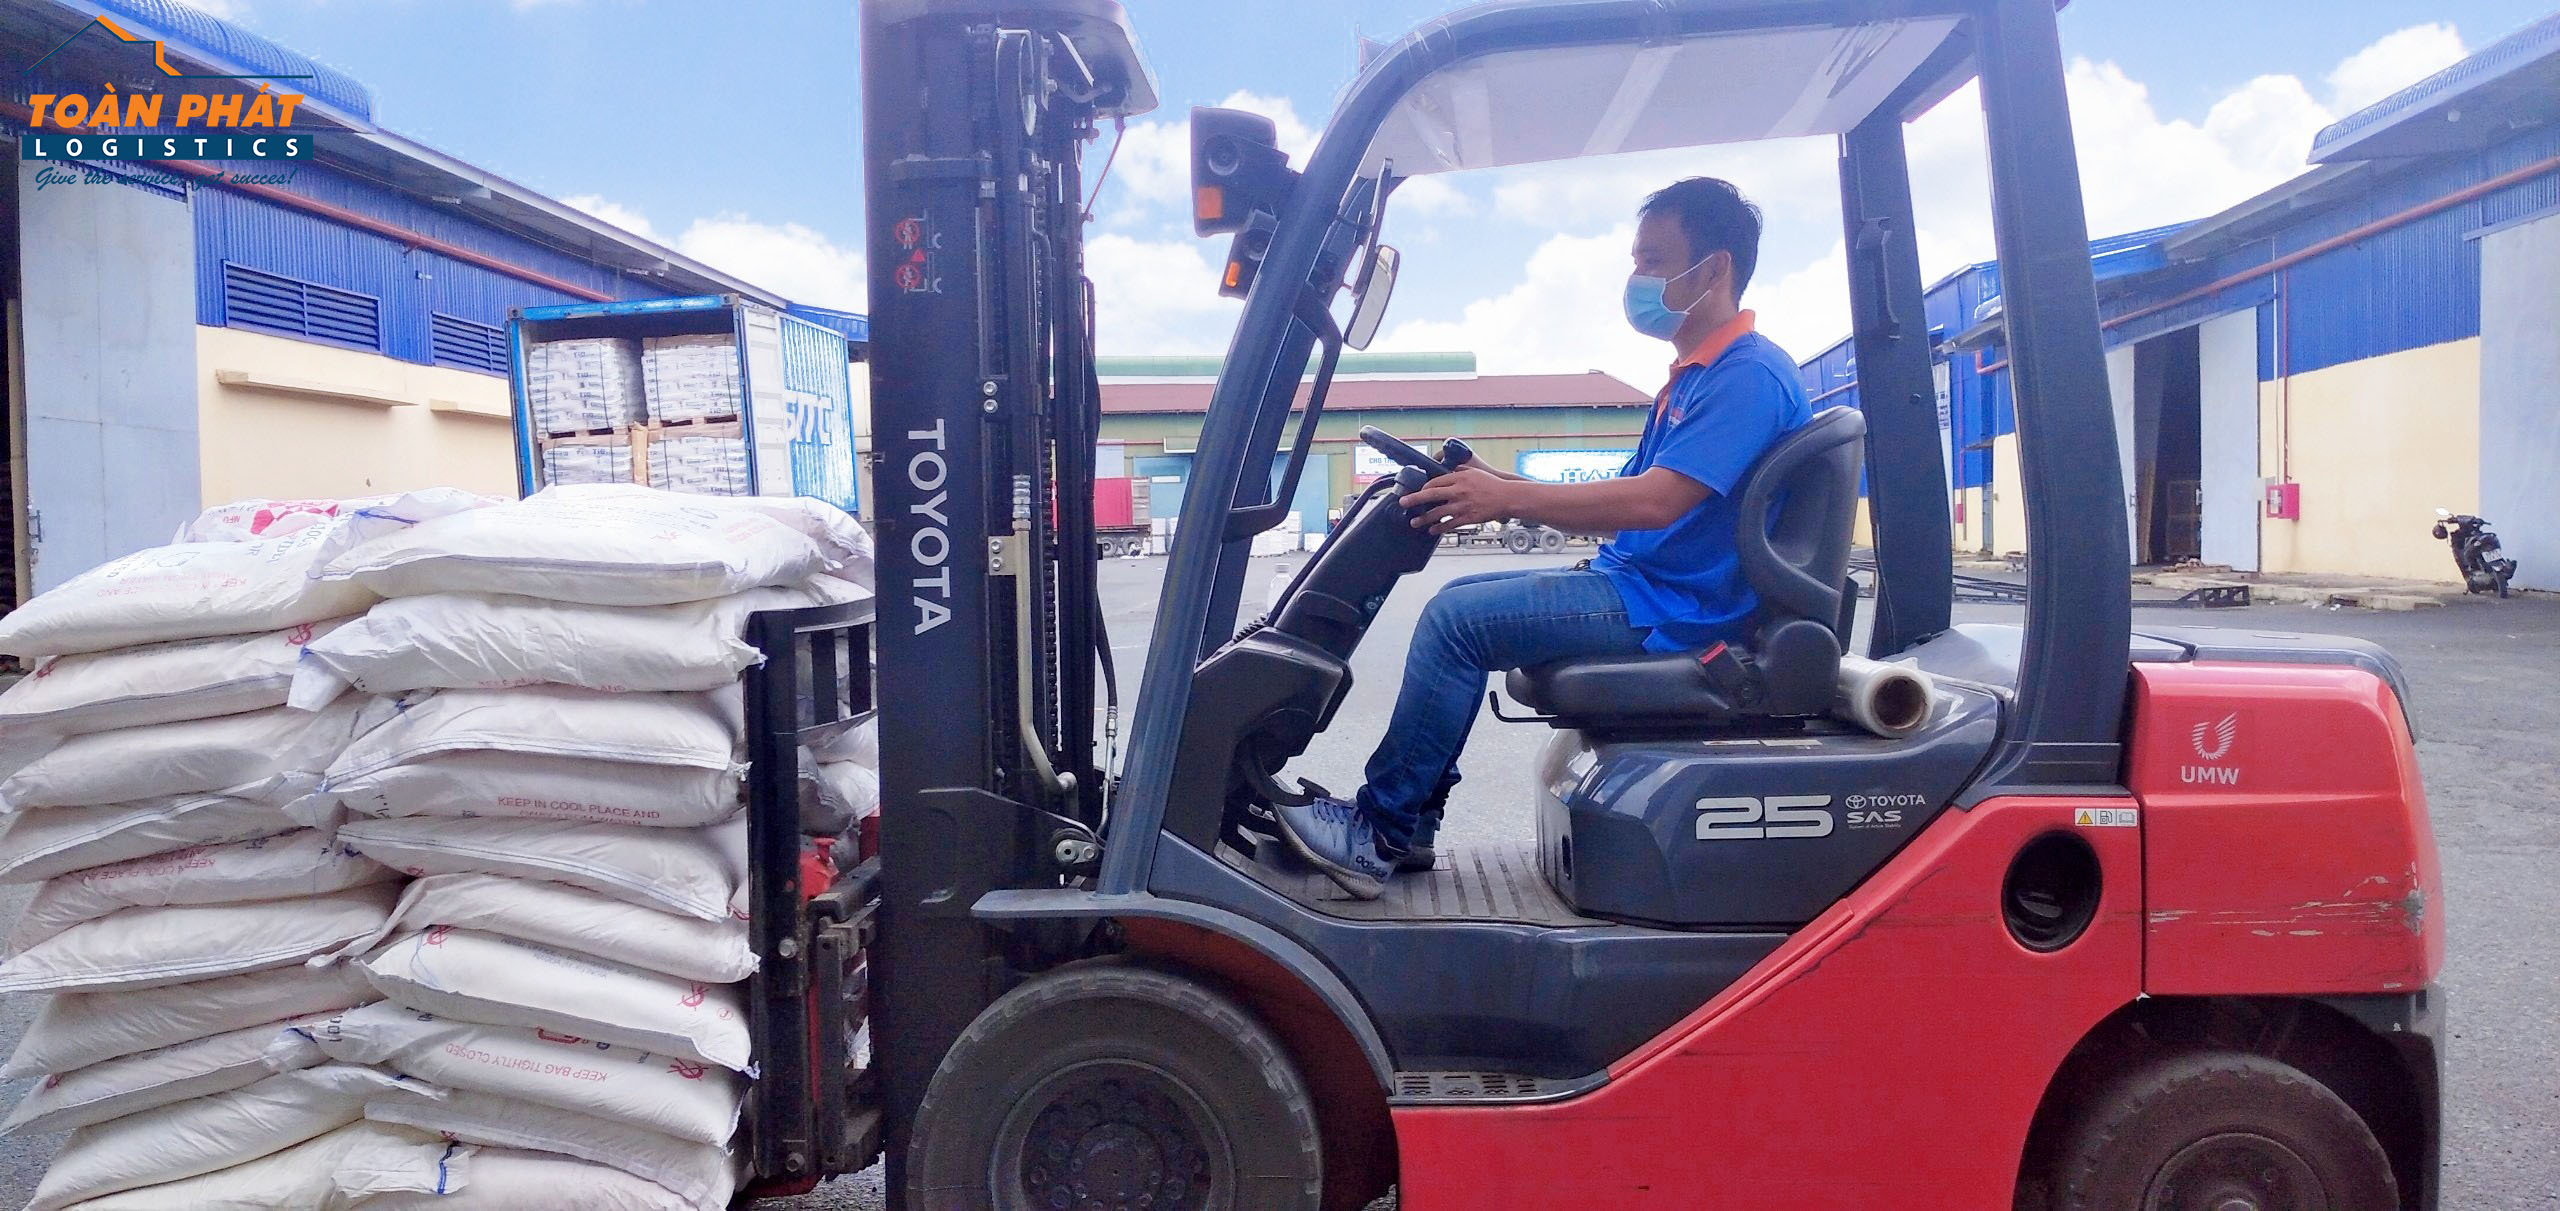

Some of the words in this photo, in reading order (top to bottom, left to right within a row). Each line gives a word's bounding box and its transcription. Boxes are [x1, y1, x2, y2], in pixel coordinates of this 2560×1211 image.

[907, 418, 952, 636] TOYOTA
[2180, 766, 2241, 786] UMW
[497, 796, 531, 808] KEEP
[534, 799, 547, 809] IN
[550, 800, 586, 813] COOL
[588, 804, 632, 818] PLACE
[632, 808, 661, 819] AND
[1868, 794, 1926, 807] TOYOTA
[1694, 794, 1834, 840] 25
[1846, 809, 1902, 824] SAS
[445, 1042, 490, 1064] CLOSED
[491, 1054, 544, 1074] TIGHTLY
[544, 1063, 571, 1077] BAG
[572, 1066, 609, 1083] KEEP
